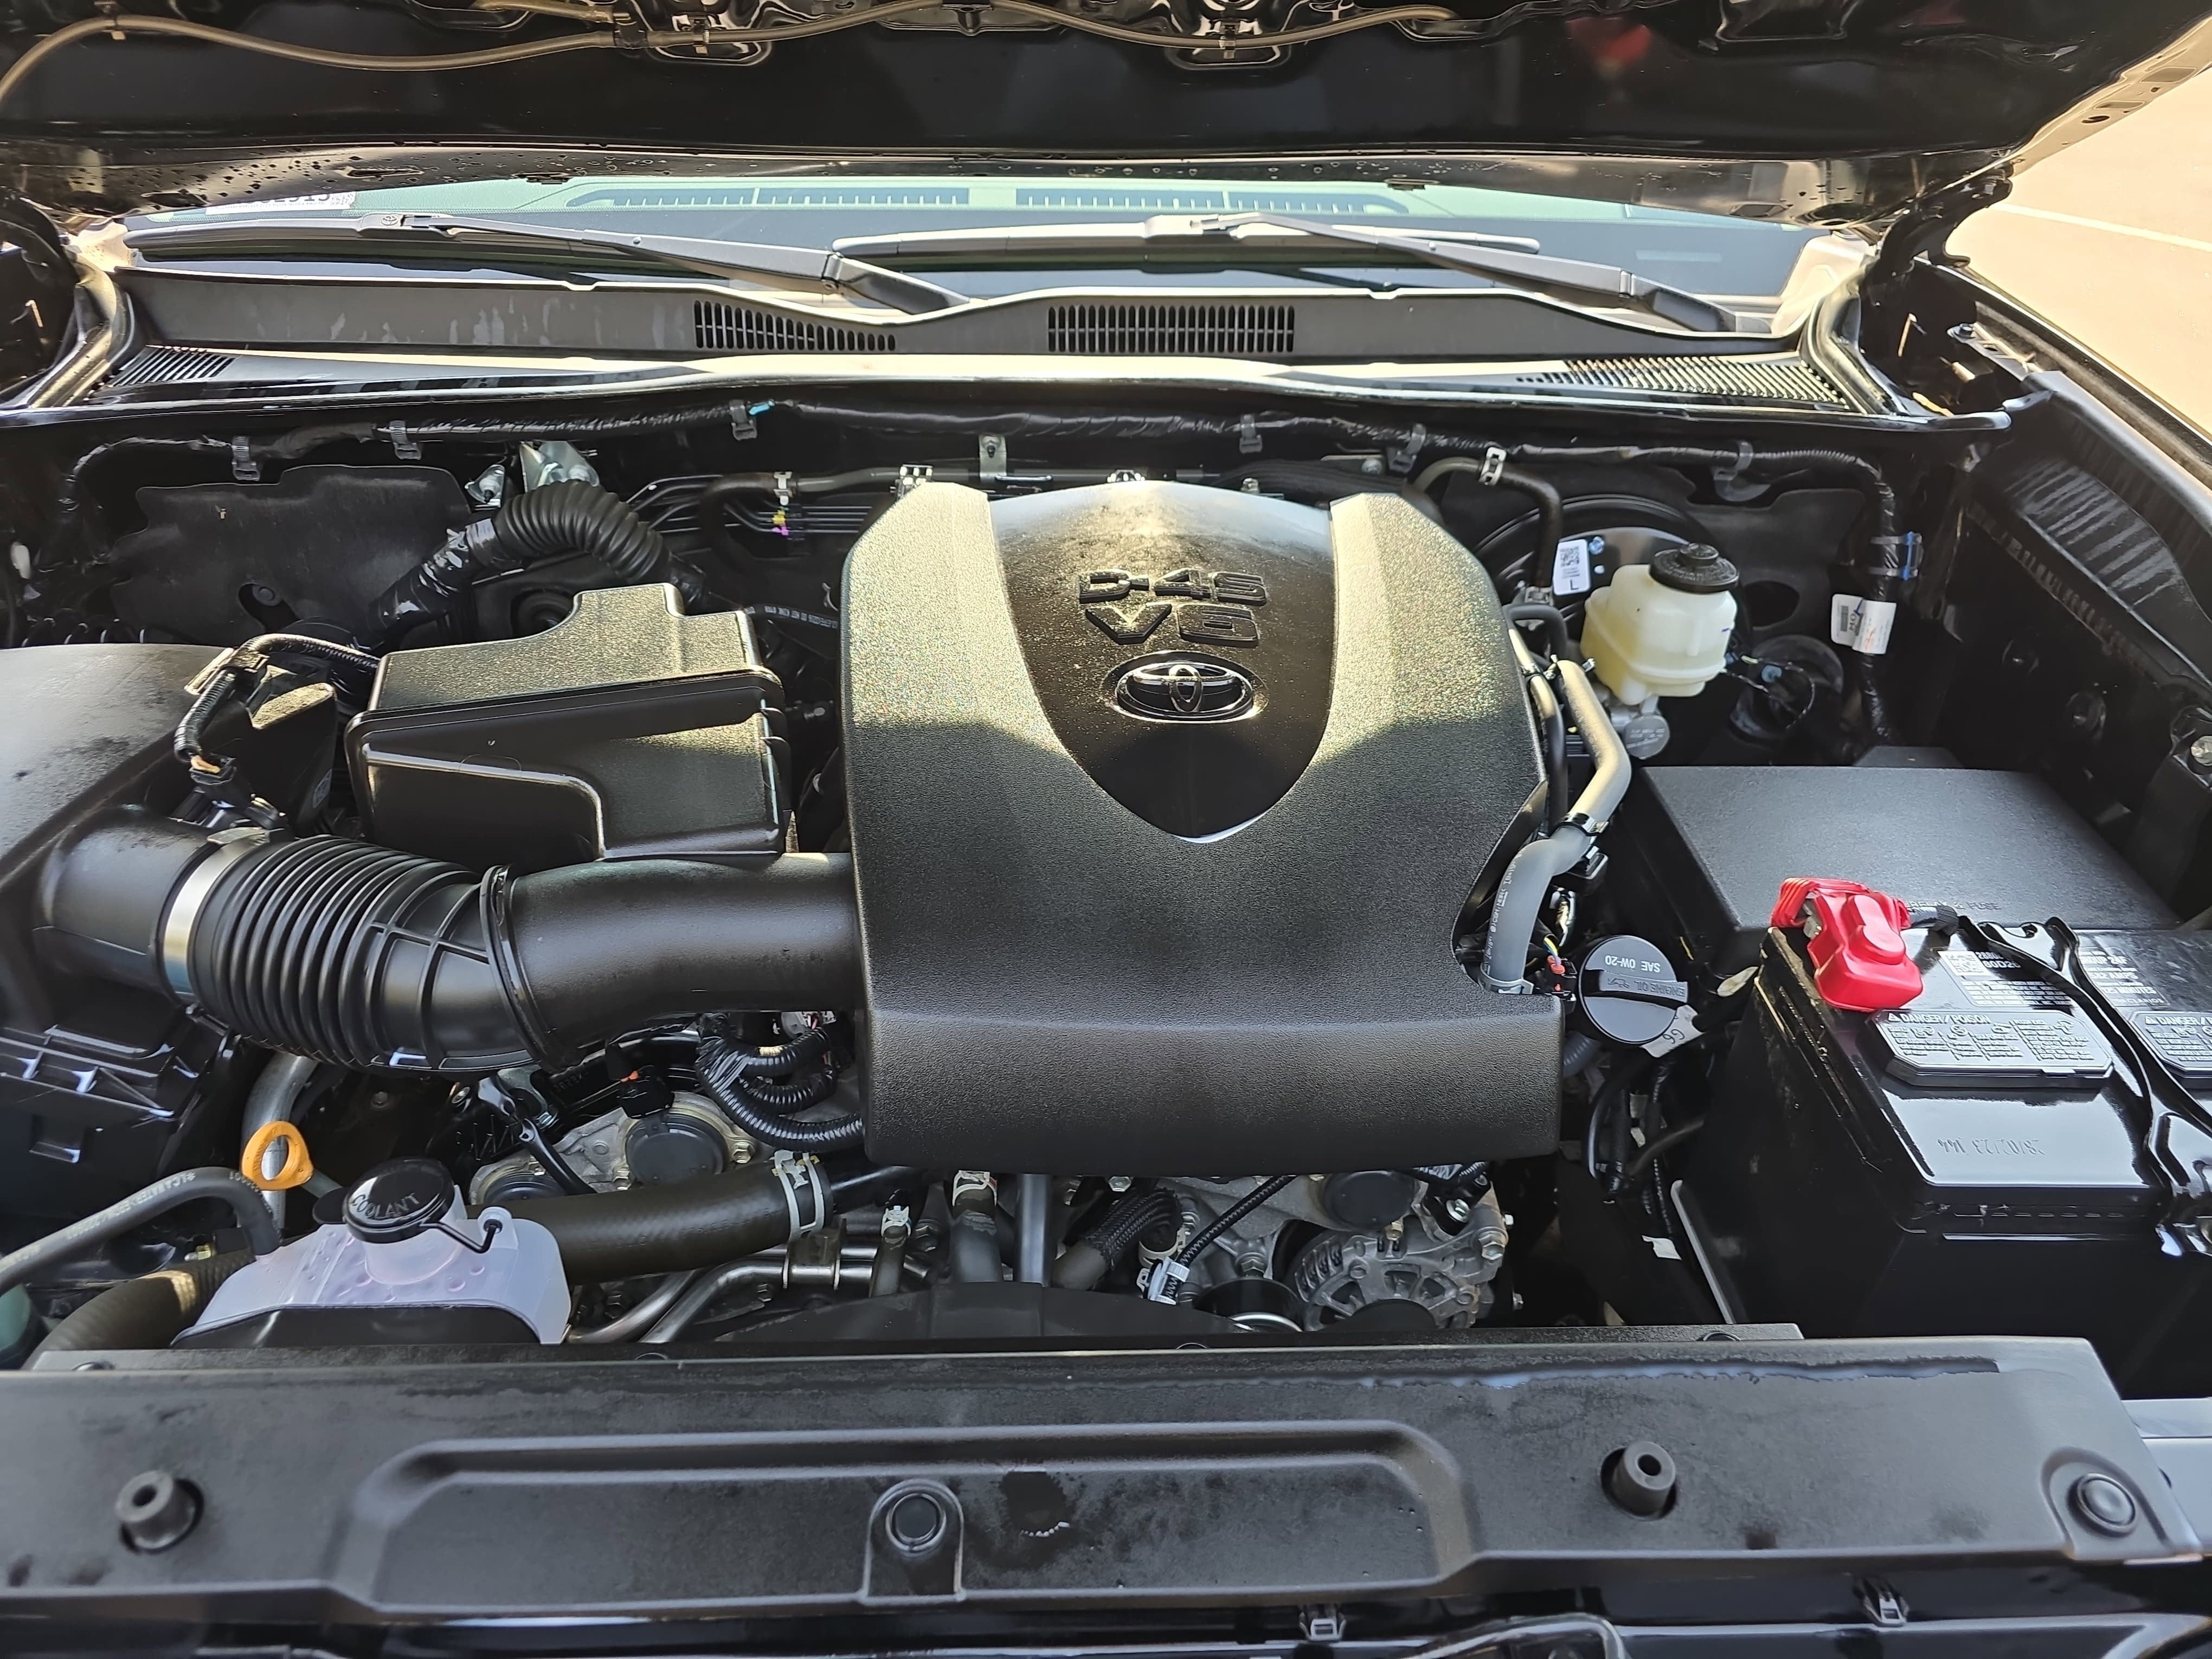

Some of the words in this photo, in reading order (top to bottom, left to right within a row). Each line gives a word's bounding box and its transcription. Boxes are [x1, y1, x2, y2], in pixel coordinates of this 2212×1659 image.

[1078, 568, 1267, 606] D-4S
[1570, 579, 1579, 590] L
[1085, 602, 1261, 648] V6
[1967, 902, 2002, 910] FUSE
[1605, 955, 1636, 969] 0W-20
[1641, 961, 1661, 973] SAE
[1634, 980, 1649, 992] OIL
[1650, 983, 1686, 997] ENGINE
[1899, 1014, 1944, 1024] DANGER
[1952, 1014, 1992, 1024] POISON
[2156, 1017, 2201, 1026] DANGER
[352, 1193, 420, 1218] COOLANT
